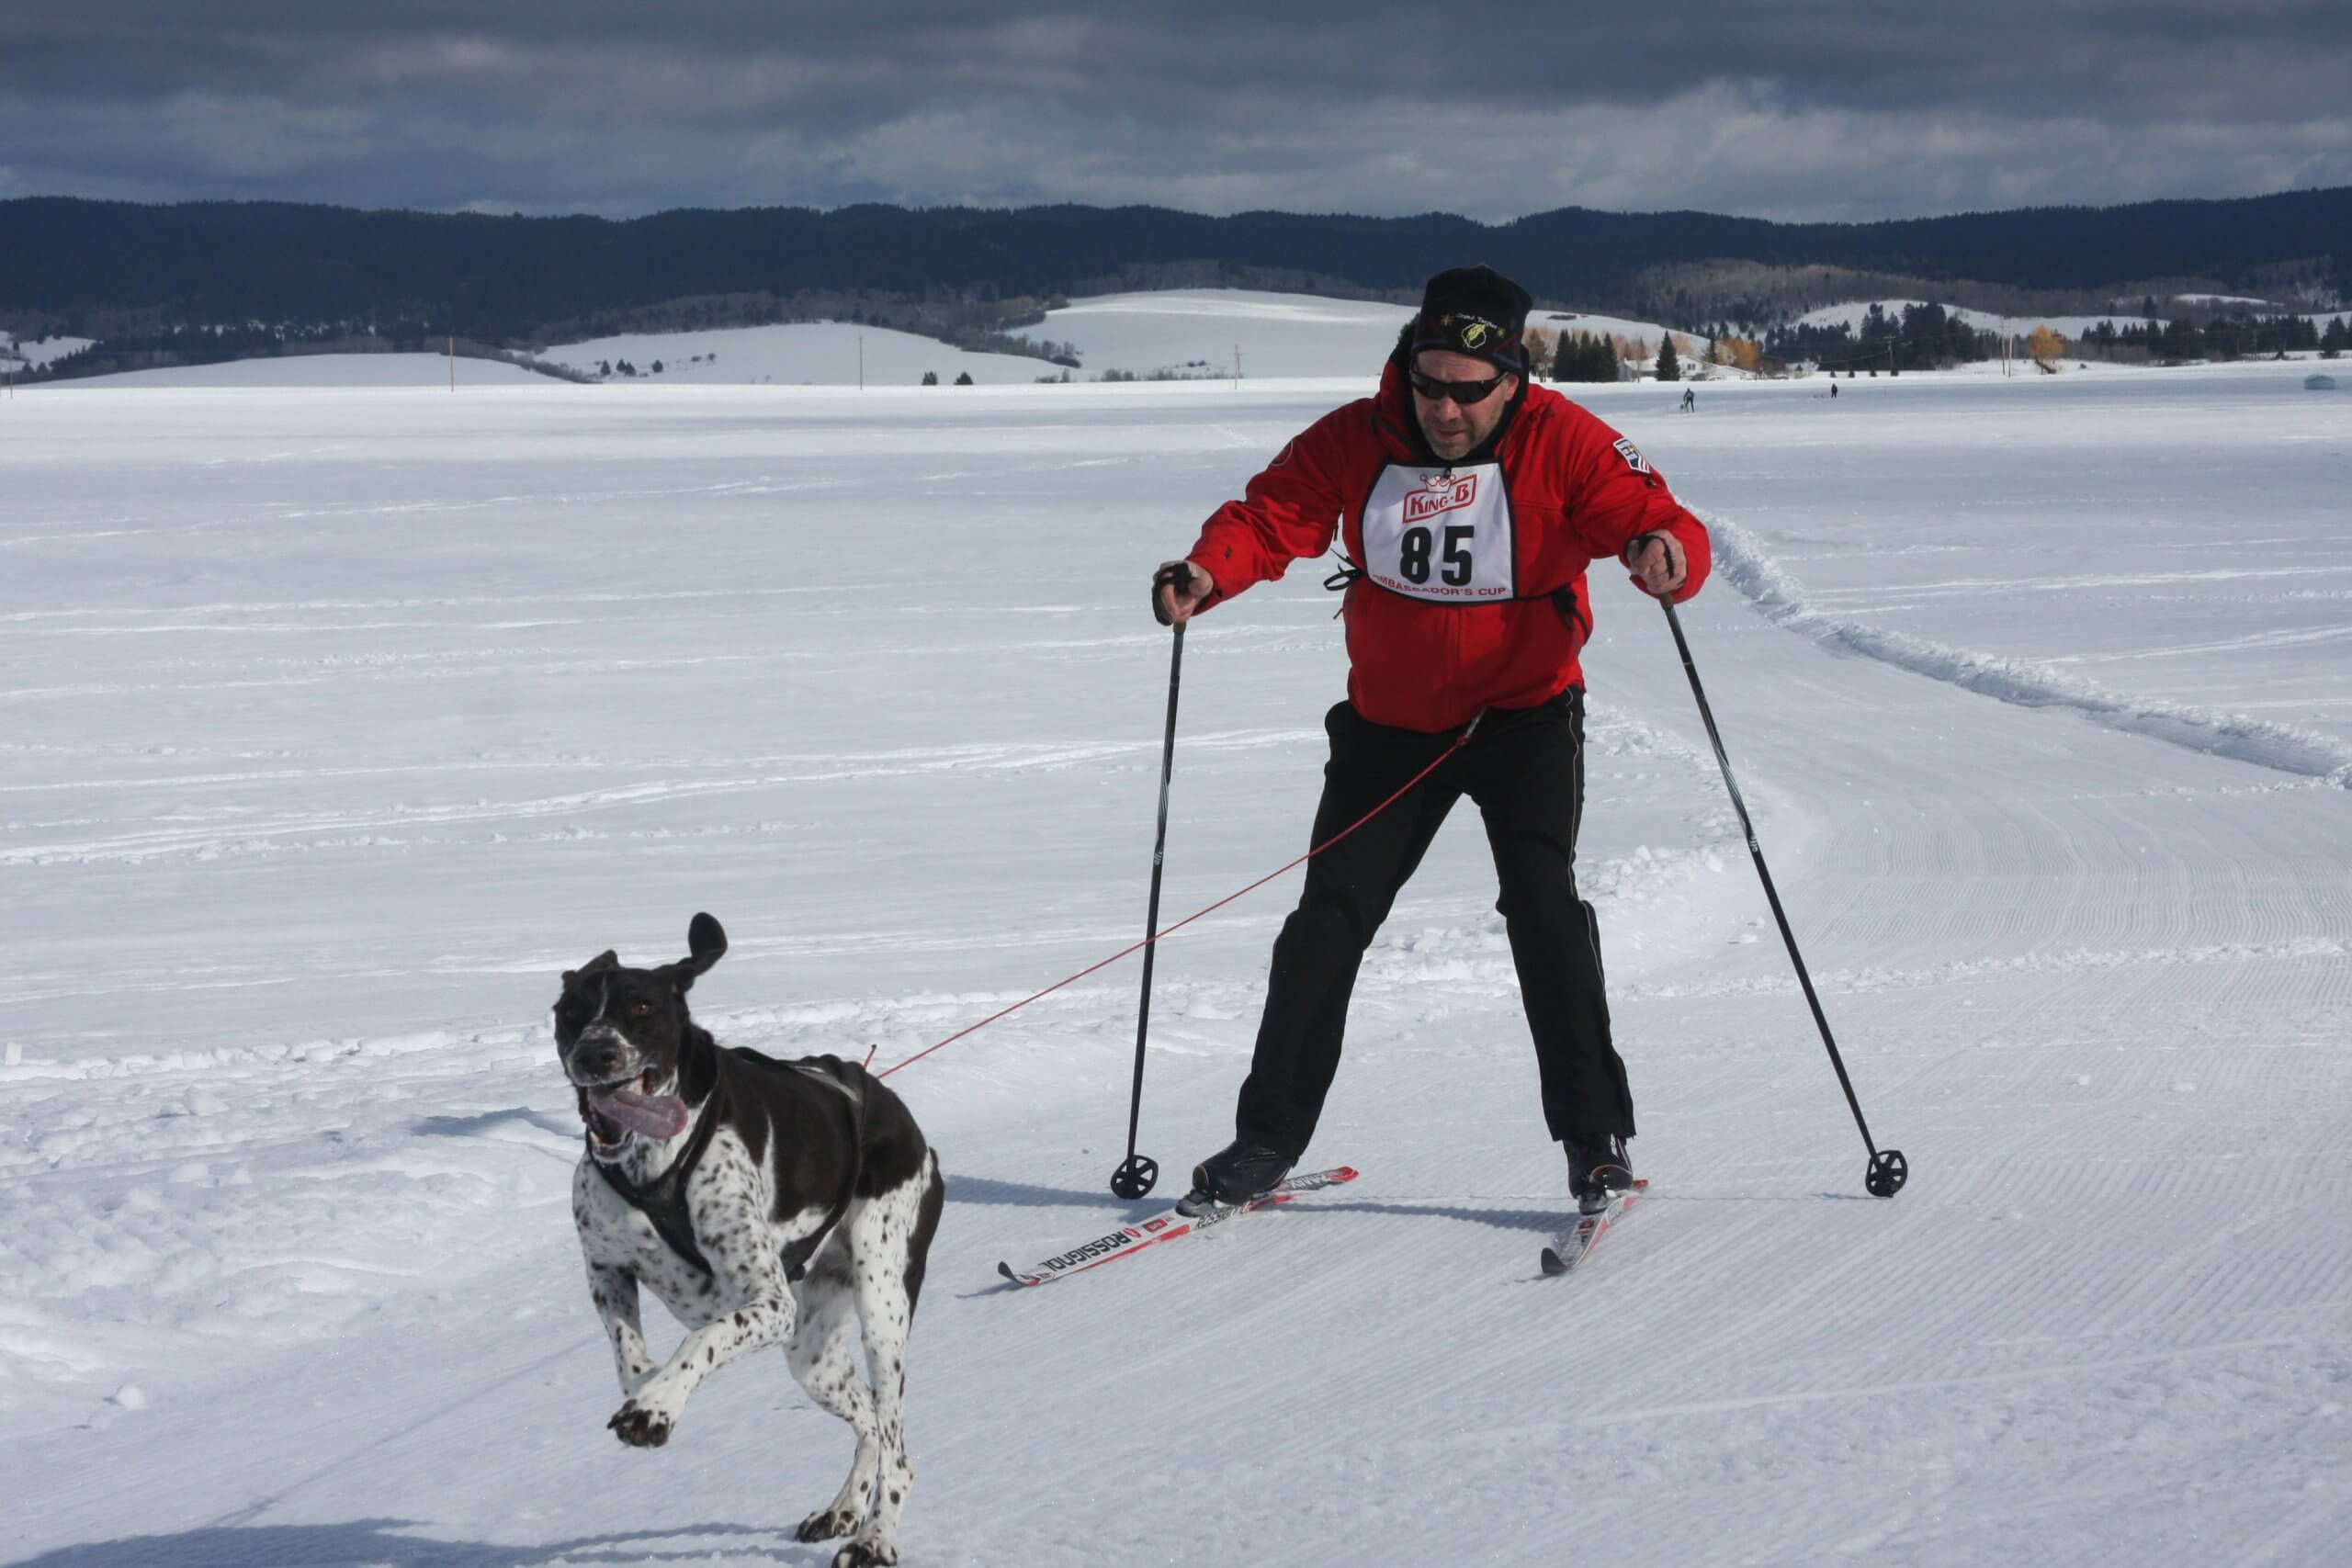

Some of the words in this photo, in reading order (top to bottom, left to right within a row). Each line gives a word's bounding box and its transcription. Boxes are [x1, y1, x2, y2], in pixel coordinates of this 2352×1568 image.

[1399, 525, 1475, 587] 85
[1373, 574, 1473, 596] MBASSADOR'S
[1478, 587, 1507, 596] CUP
[1038, 1230, 1132, 1272] ROSSIGNOL
